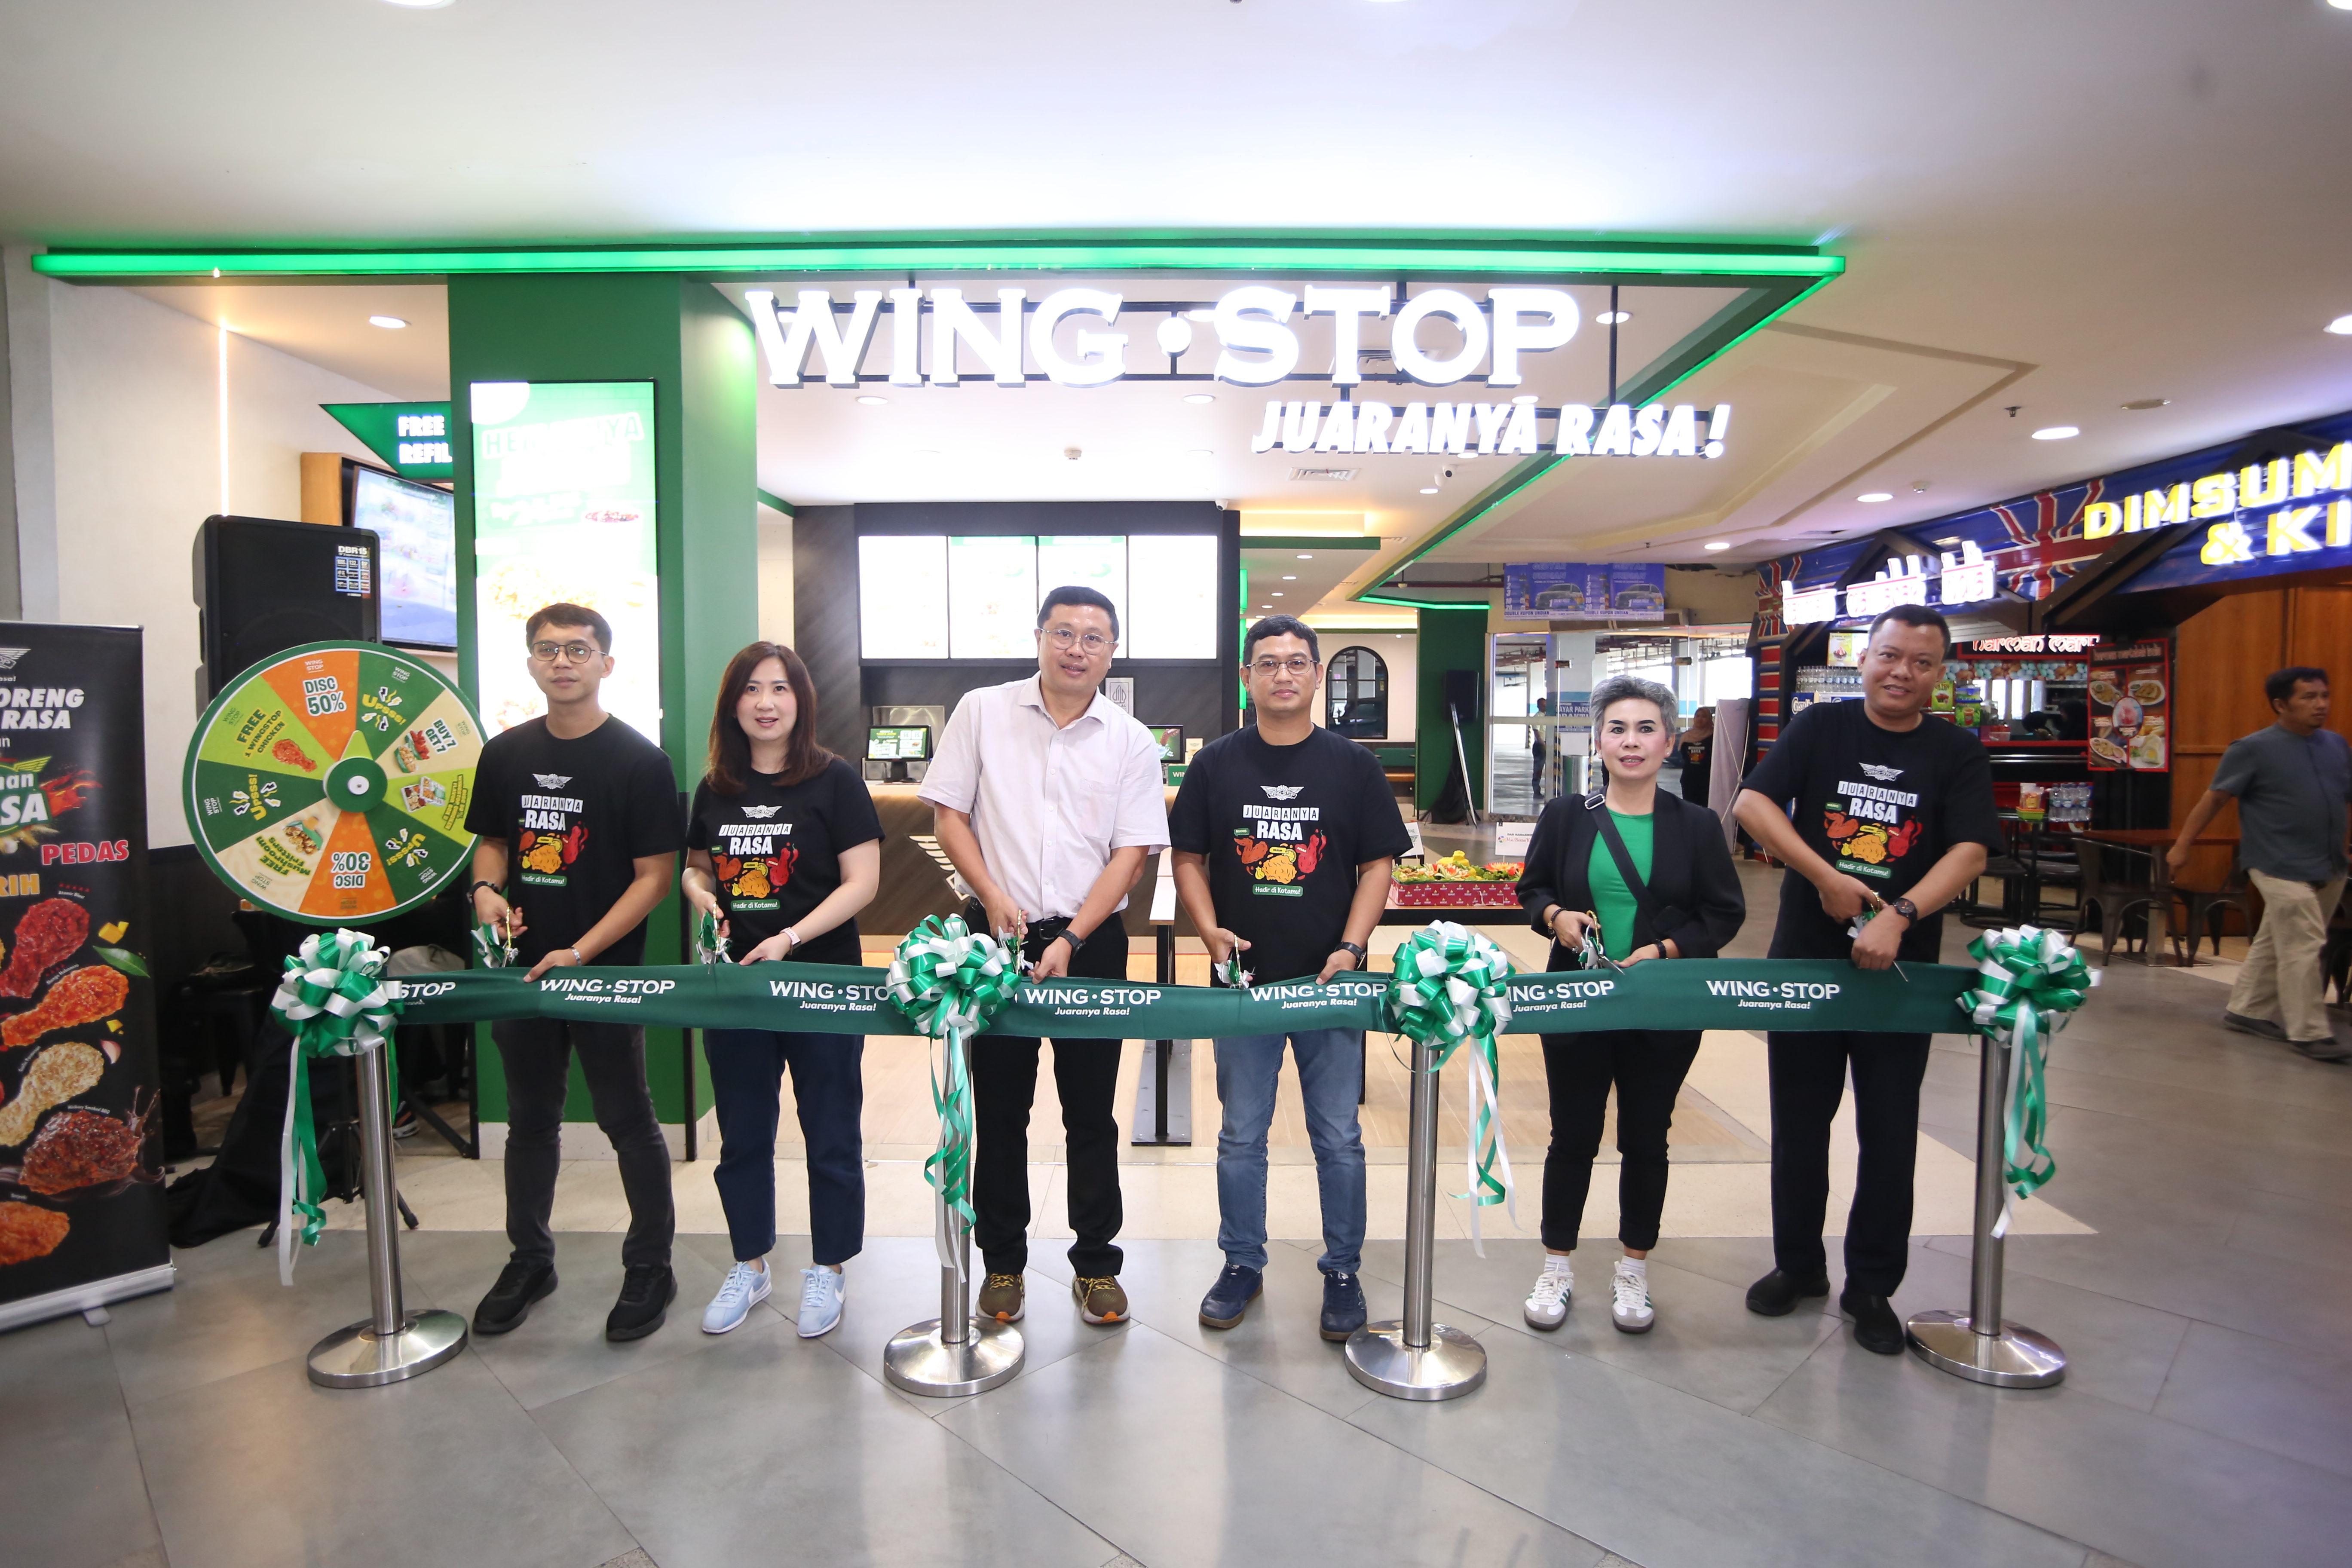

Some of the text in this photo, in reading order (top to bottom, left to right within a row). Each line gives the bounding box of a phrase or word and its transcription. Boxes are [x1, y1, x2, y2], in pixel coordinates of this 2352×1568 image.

[398, 414, 445, 437] FREE
[1251, 401, 1731, 460] JUARANYA RASA!
[398, 442, 452, 464] REFIL
[2083, 439, 2352, 540] DIMSUM
[2200, 496, 2352, 565] & KI
[338, 545, 368, 555] DBR15
[303, 677, 337, 695] DISC
[0, 688, 85, 708] ORENG
[306, 692, 345, 715] 50%
[1, 710, 71, 729] RASA
[236, 708, 266, 743] FREE
[248, 710, 282, 750] WINGSTOP
[433, 719, 453, 740] BUY
[257, 721, 286, 753] CHICKEN
[425, 728, 446, 753] GET 7
[1838, 781, 1917, 807] JUARANYA
[0, 793, 49, 826] SA
[524, 809, 566, 831] RASA
[1243, 805, 1319, 821] JUARANYA
[1849, 798, 1898, 824] RASA
[719, 824, 792, 836] JUARANYA
[1256, 820, 1303, 841] RASA
[42, 839, 129, 866] PEDAS
[729, 836, 773, 855] RASA
[260, 855, 290, 876] FREE
[331, 852, 371, 873] 30%
[1838, 861, 1856, 870] Hadir
[1862, 866, 1888, 877] Kotamu!
[334, 875, 364, 887] DISC
[542, 877, 565, 885] Kotamu!
[401, 982, 456, 998] STOP
[564, 993, 642, 1004] Juaranya Rasa!
[769, 980, 890, 1001] WING·STO
[1507, 980, 1614, 1002] ING·STOP
[799, 1001, 877, 1012] Juaranya Rasa!
[1054, 1007, 1130, 1017] Juaranya Rasa!
[1281, 998, 1357, 1009] Juaranya Rasa!
[1513, 1000, 1587, 1012] Juaranya Rasa!
[1737, 999, 1811, 1010] Juaranya Rasa!
